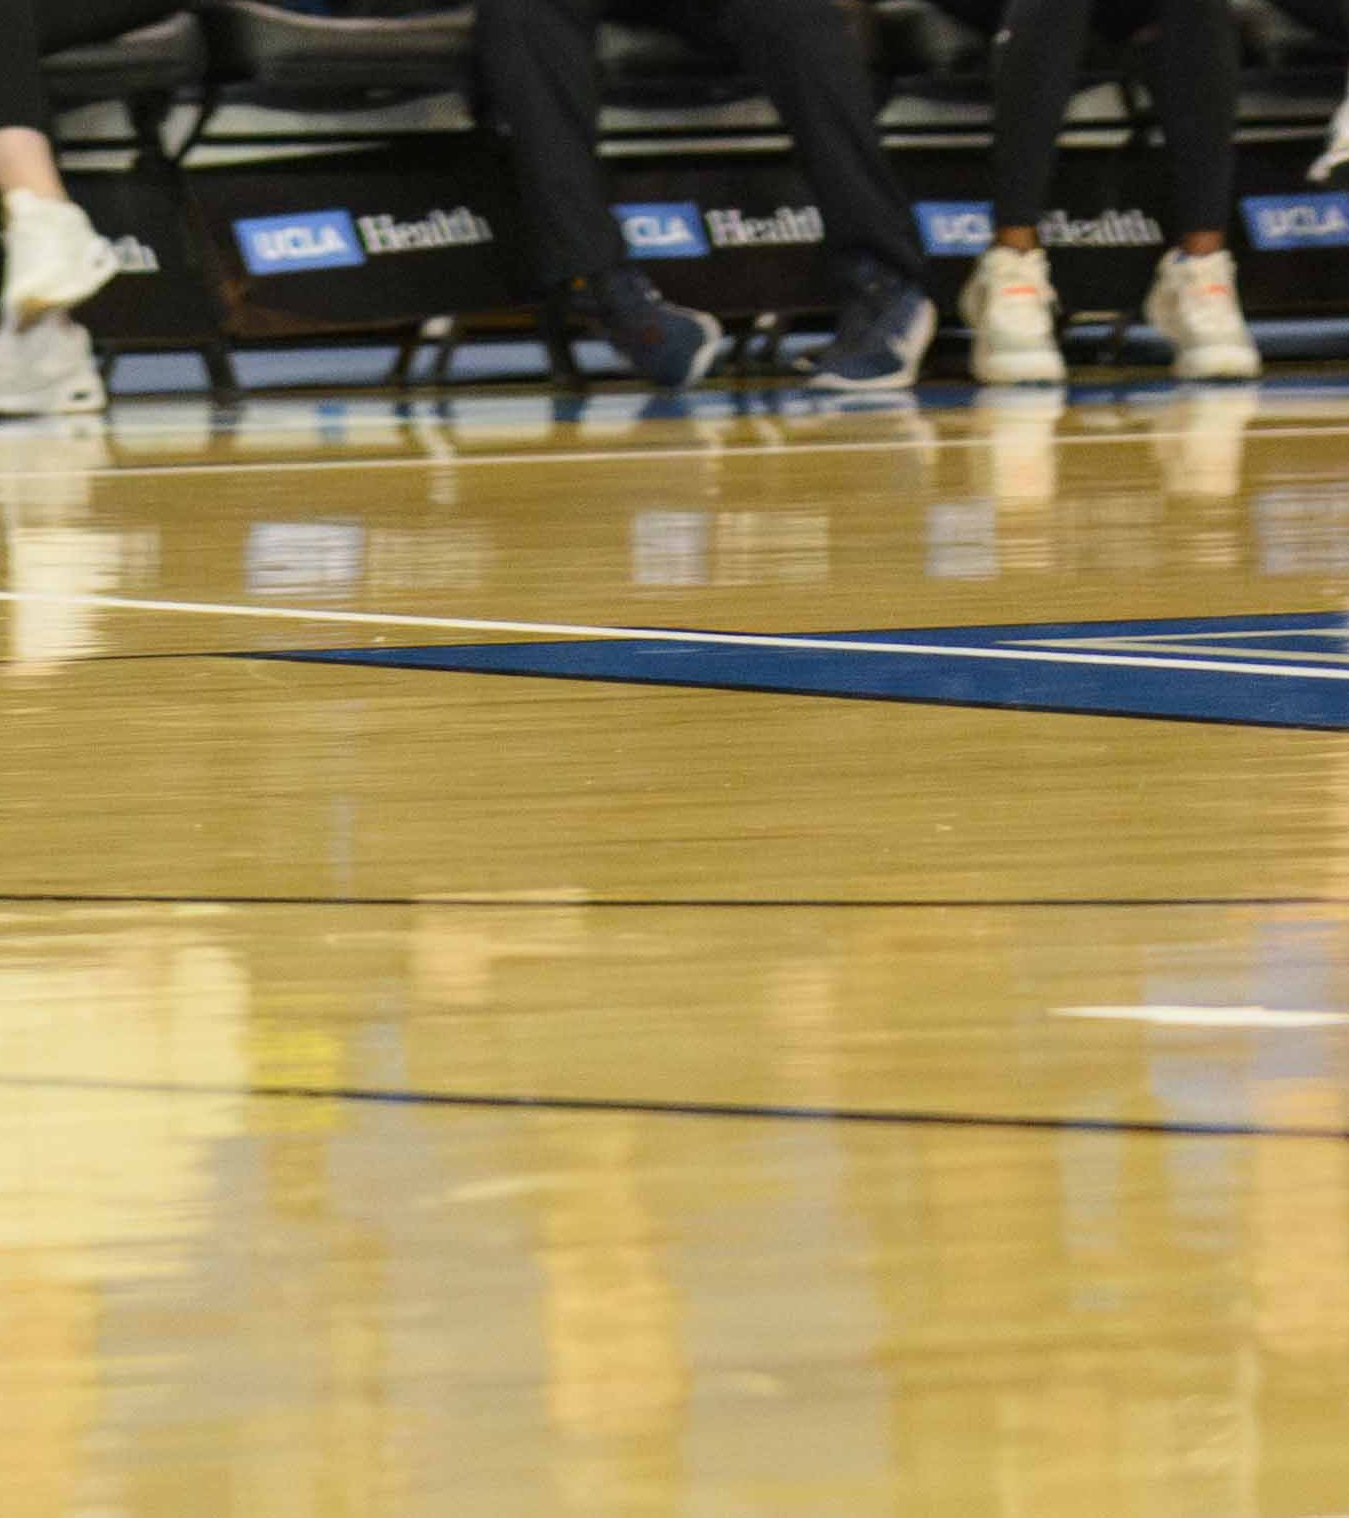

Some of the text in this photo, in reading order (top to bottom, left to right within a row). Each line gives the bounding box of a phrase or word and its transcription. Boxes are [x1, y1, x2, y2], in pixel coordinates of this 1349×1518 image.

[254, 205, 494, 261] UCLA Health
[621, 215, 697, 247] CLA
